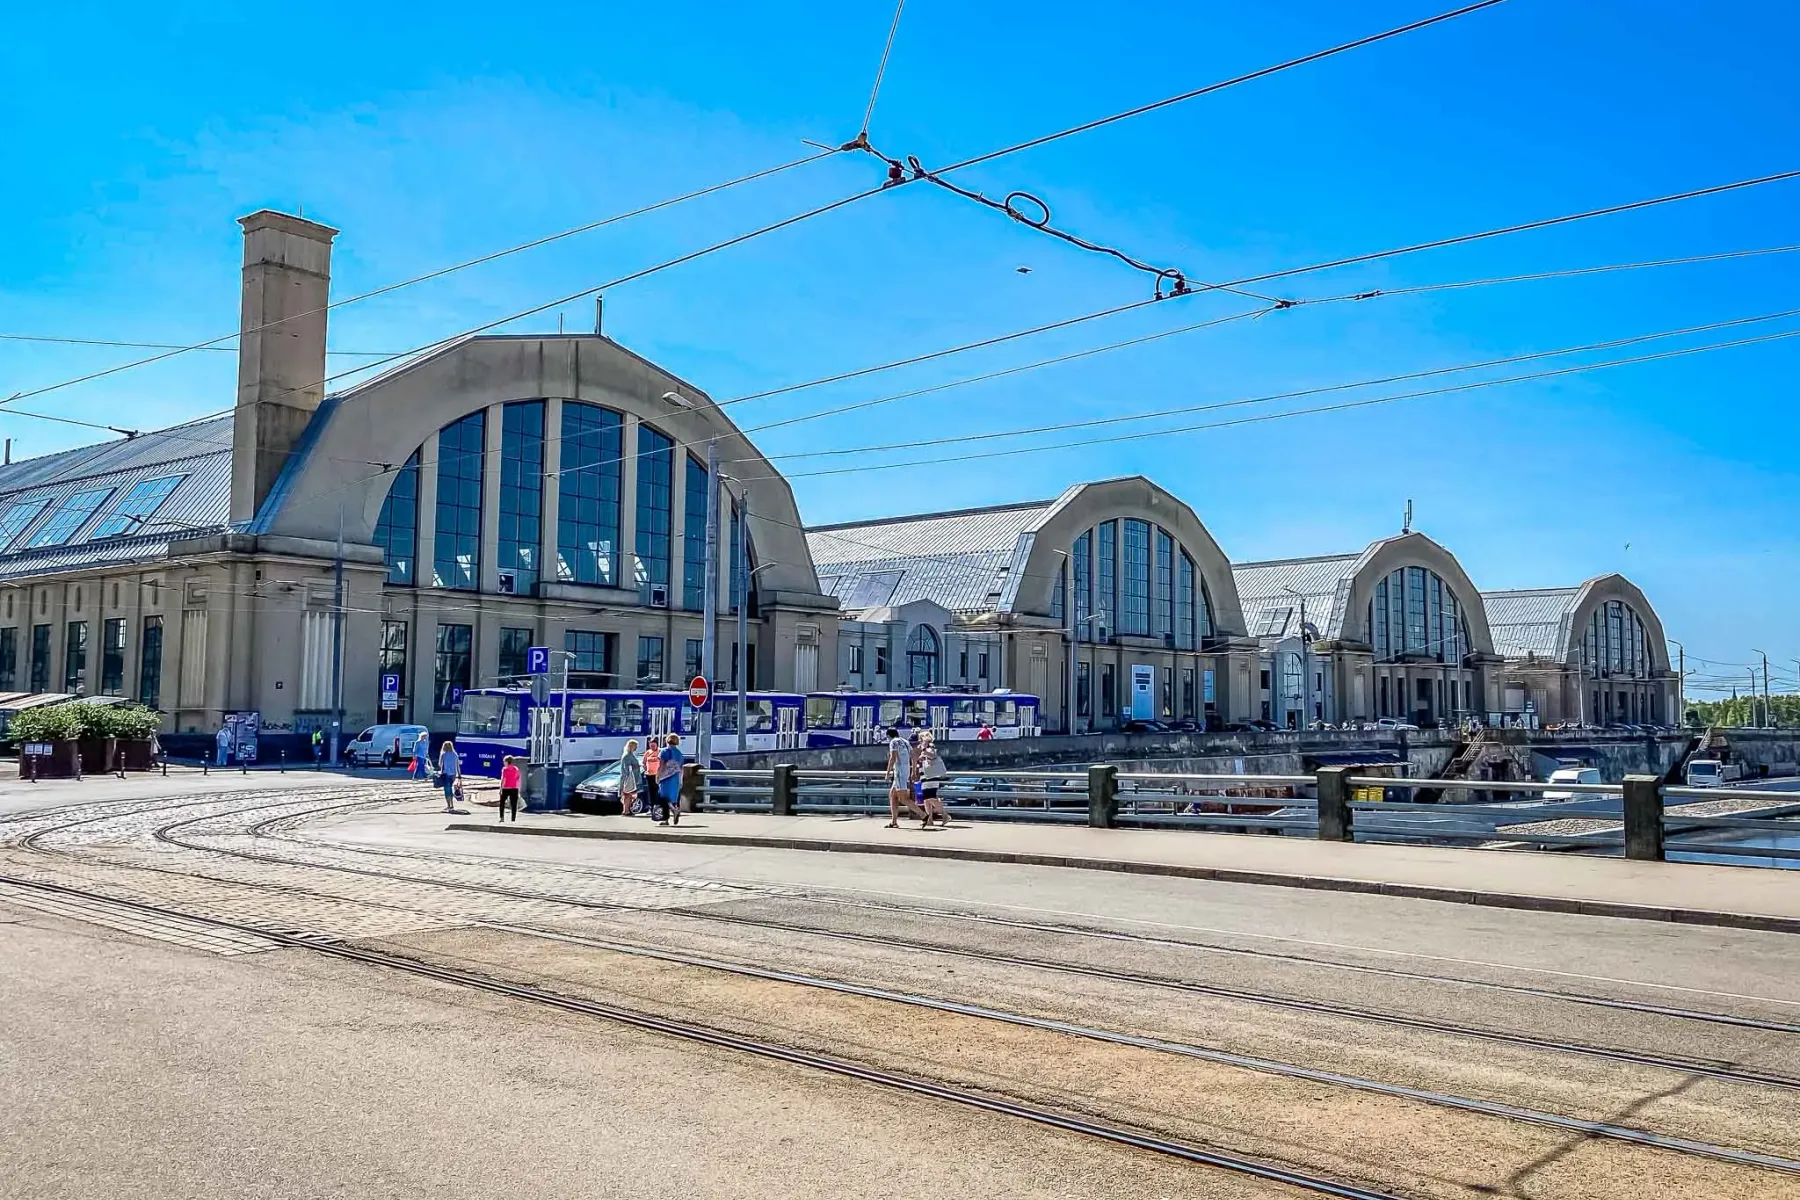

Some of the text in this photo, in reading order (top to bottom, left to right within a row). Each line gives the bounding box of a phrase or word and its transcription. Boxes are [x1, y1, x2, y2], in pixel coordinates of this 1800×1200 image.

[533, 650, 544, 671] P
[386, 677, 395, 690] P
[453, 688, 459, 700] P
